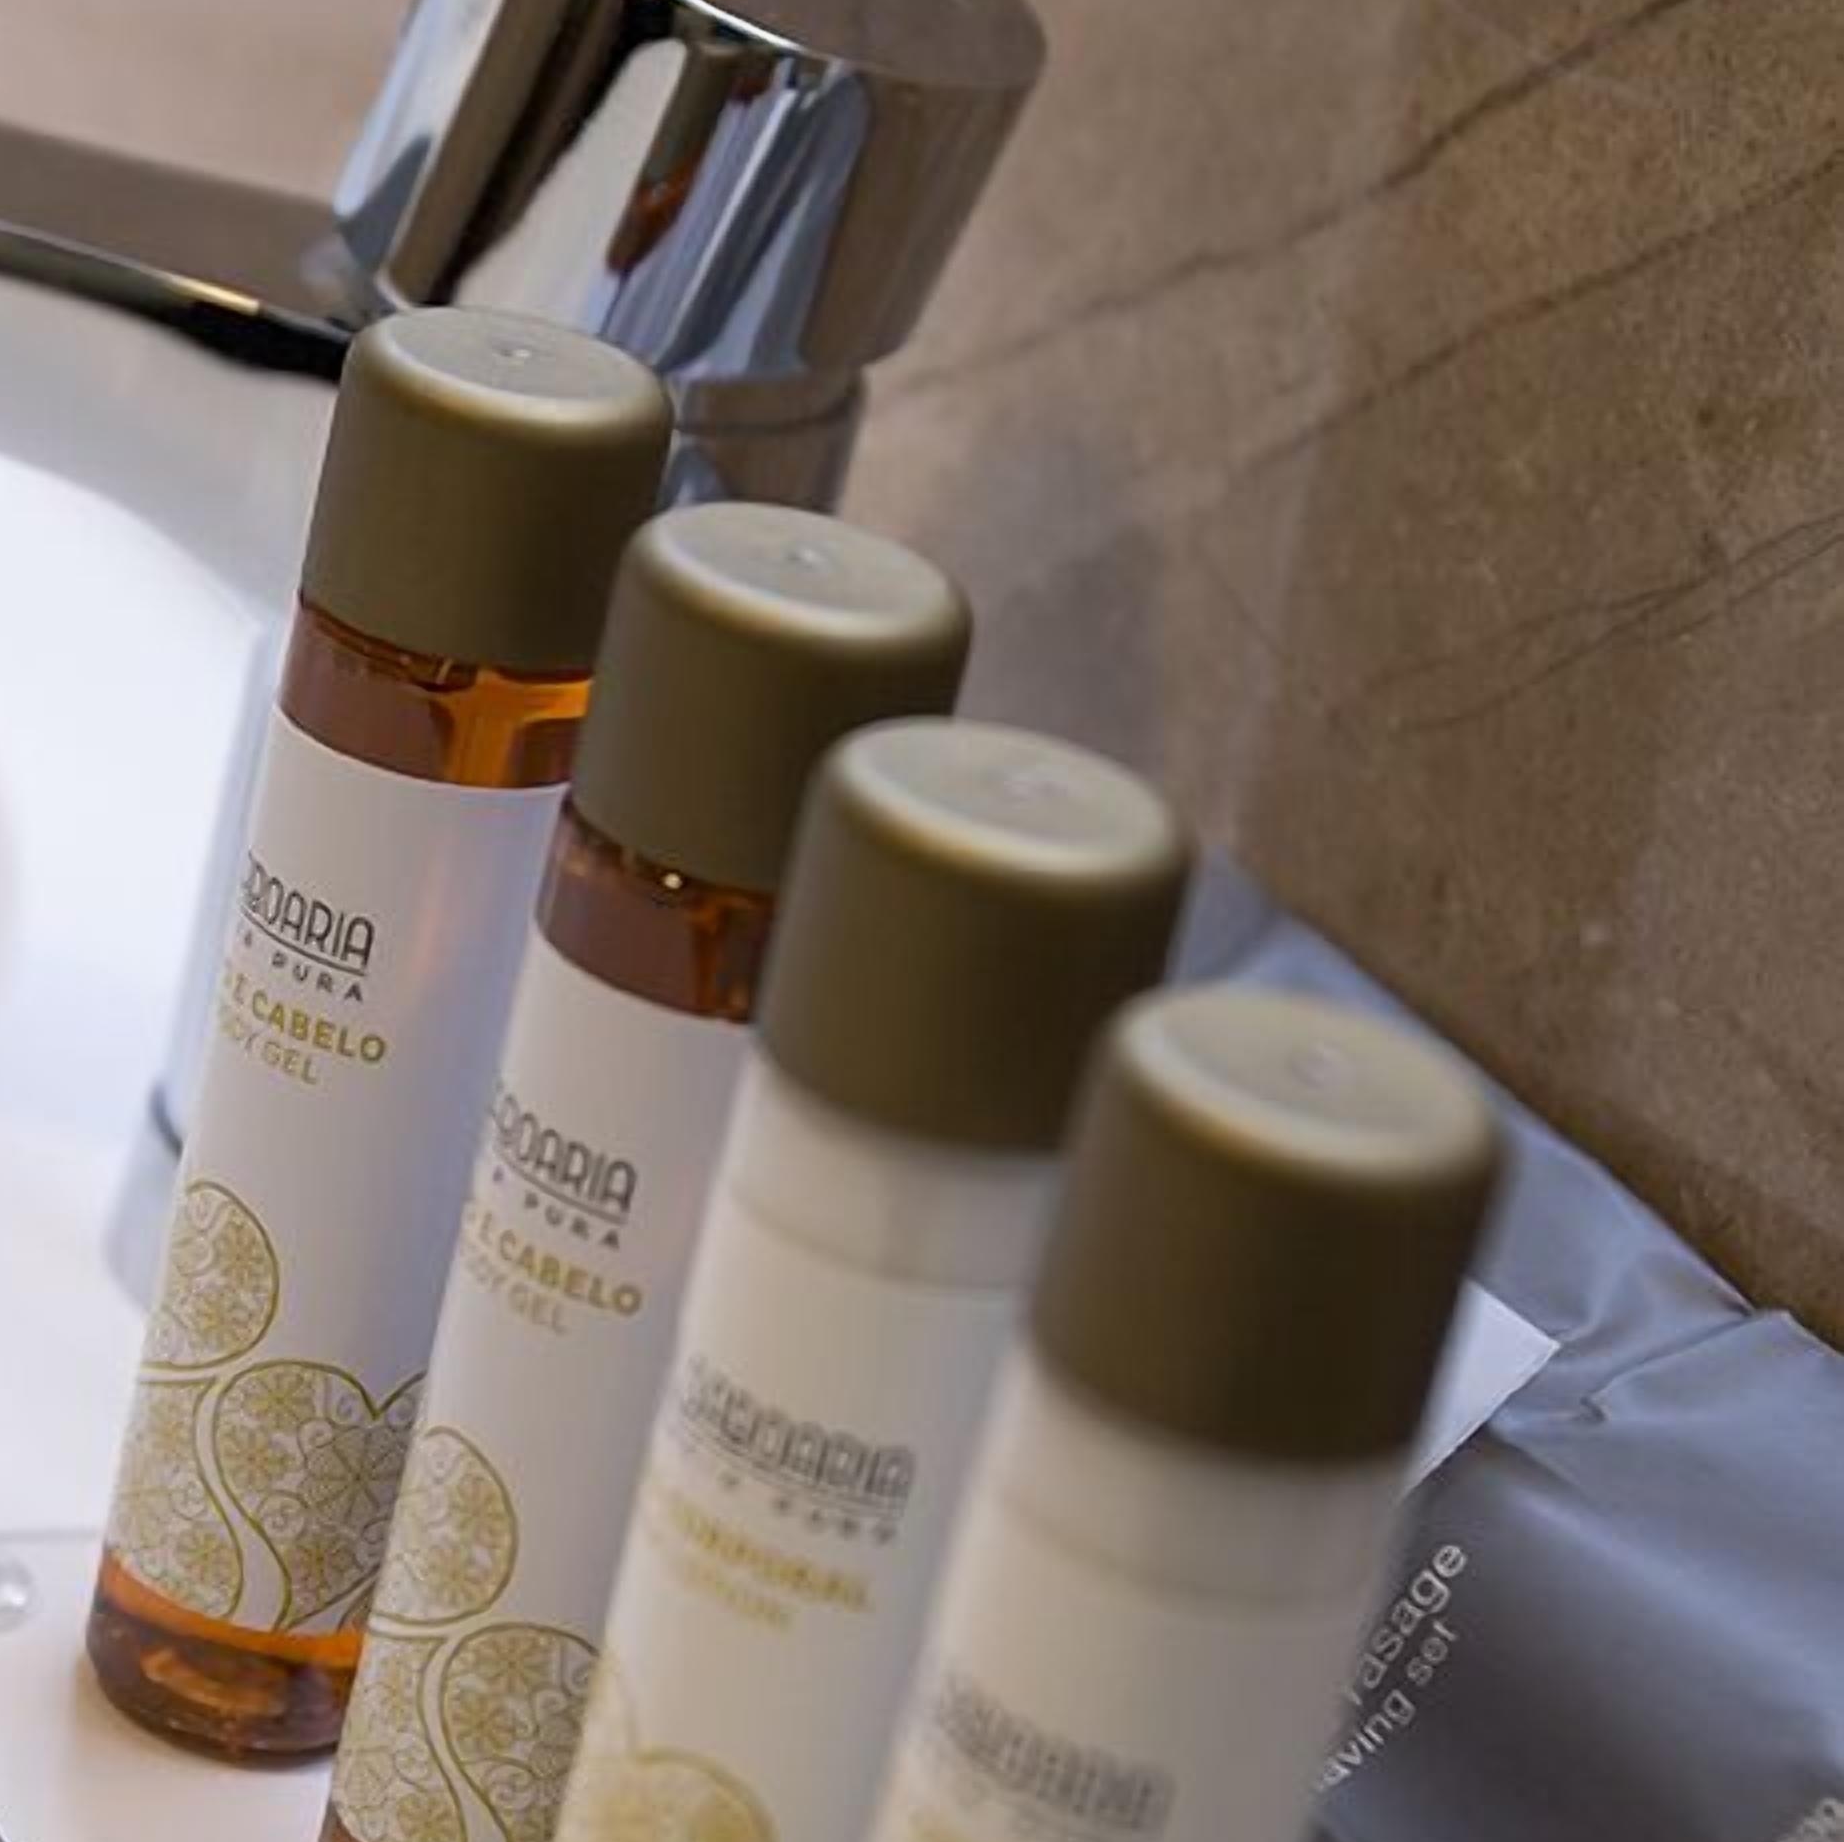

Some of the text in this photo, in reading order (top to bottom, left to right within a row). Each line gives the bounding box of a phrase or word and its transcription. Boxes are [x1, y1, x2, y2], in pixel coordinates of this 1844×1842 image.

[251, 989, 388, 1063] CABELO
[262, 1039, 319, 1086] GEL
[499, 1228, 643, 1318] CABELO
